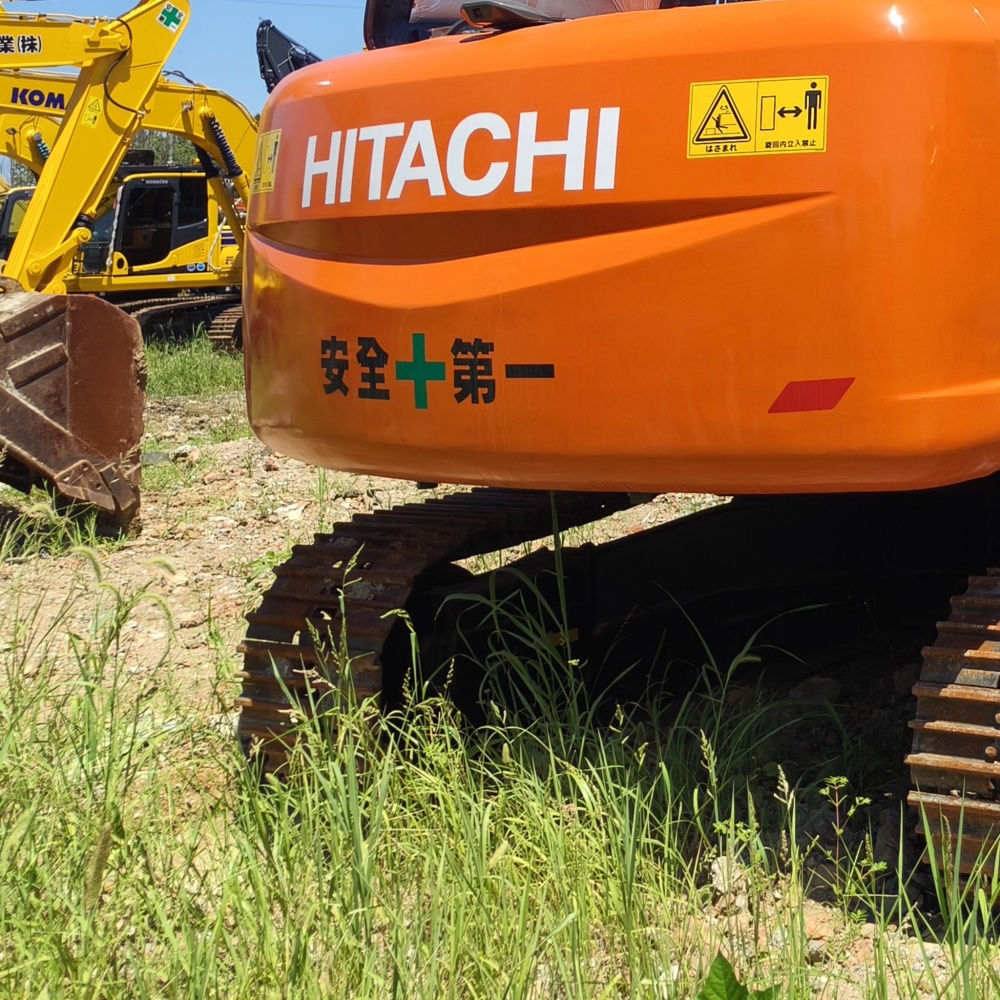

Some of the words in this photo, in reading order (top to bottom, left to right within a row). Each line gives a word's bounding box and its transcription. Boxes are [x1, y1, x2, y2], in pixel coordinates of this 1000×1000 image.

[11, 87, 65, 110] KOM
[302, 107, 620, 208] HITACHI
[705, 143, 737, 153] はさまれ
